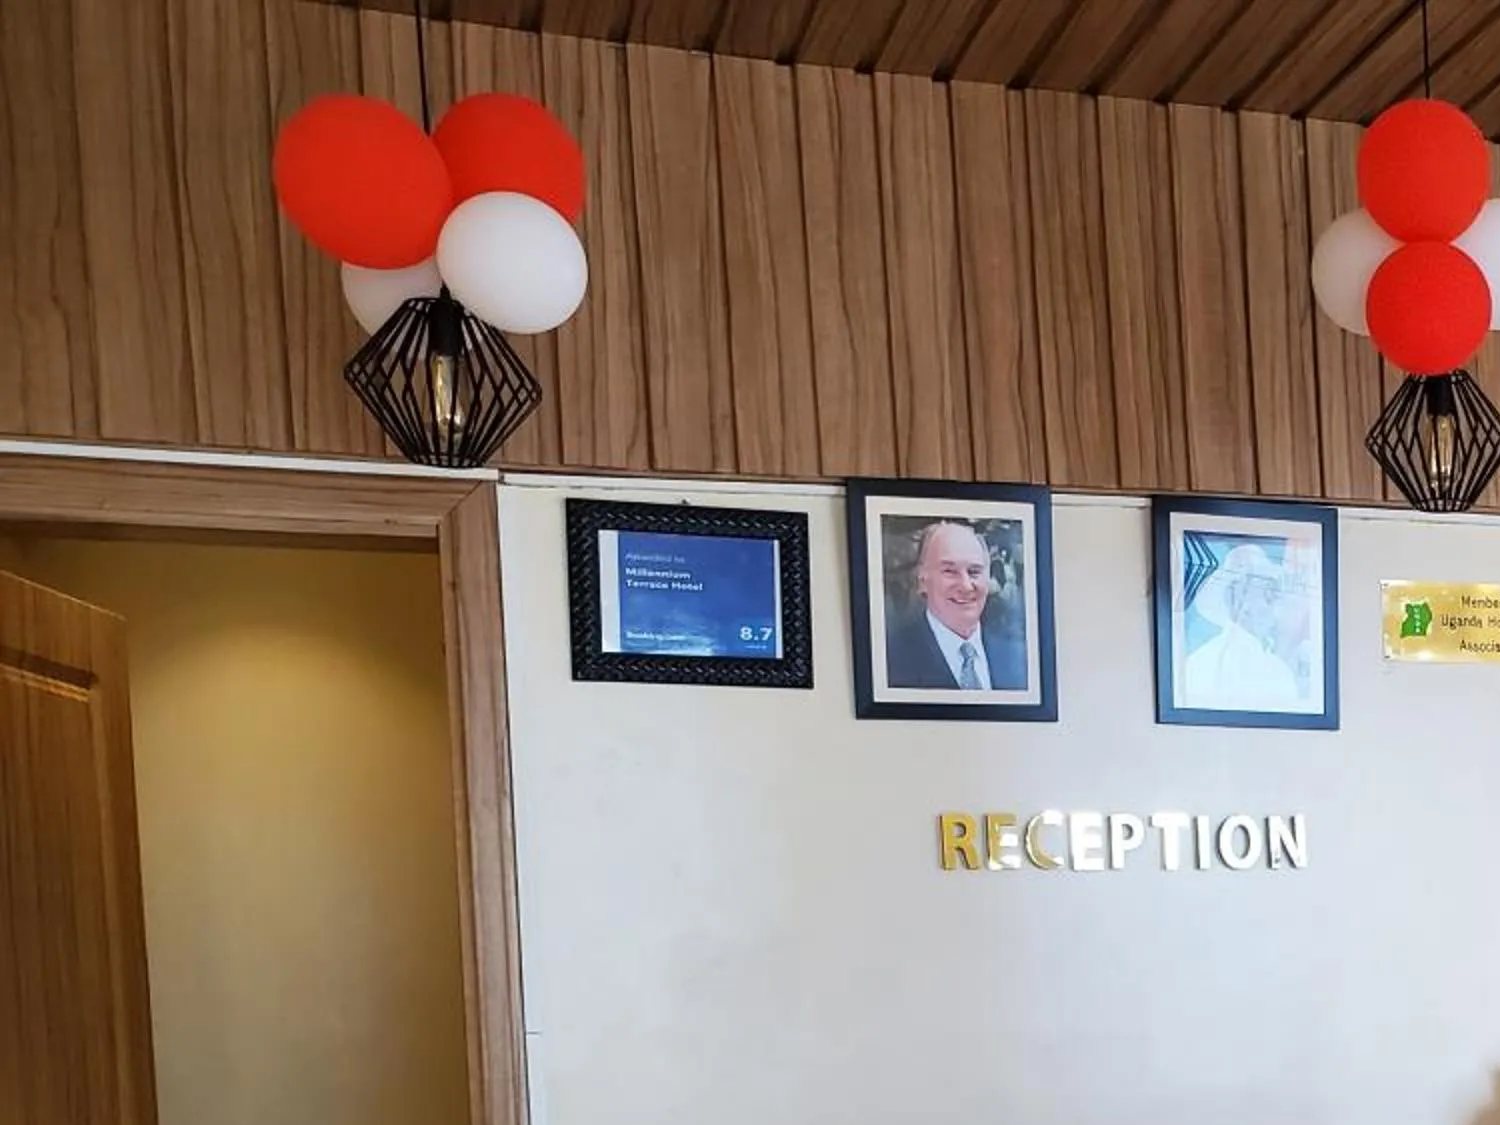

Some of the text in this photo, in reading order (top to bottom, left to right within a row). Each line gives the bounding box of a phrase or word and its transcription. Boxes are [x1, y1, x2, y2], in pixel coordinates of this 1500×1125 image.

[625, 567, 691, 579] Millennium
[626, 579, 703, 591] Terrace Hotel
[1441, 613, 1483, 630] Uganda
[739, 626, 773, 641] 8.7
[938, 810, 1309, 871] RECEPTION
